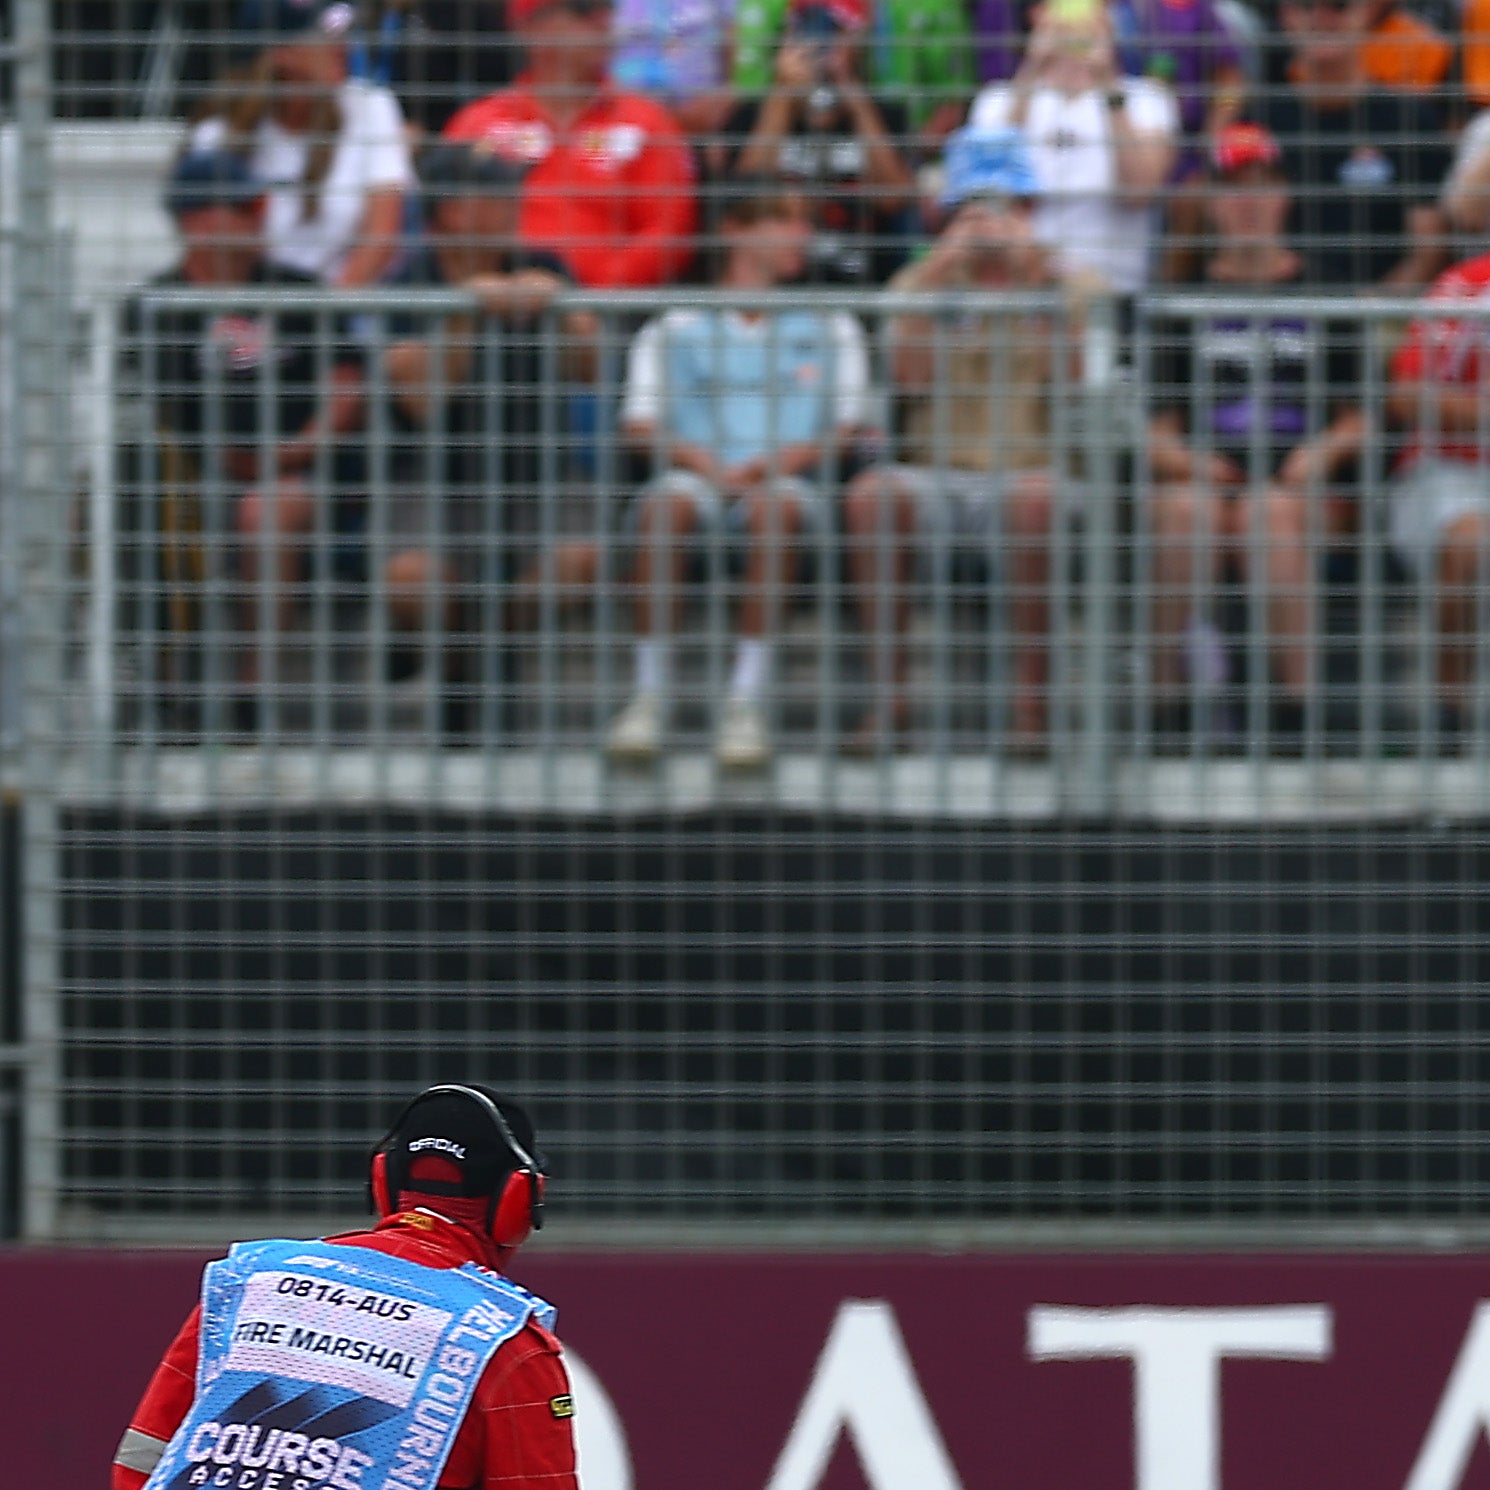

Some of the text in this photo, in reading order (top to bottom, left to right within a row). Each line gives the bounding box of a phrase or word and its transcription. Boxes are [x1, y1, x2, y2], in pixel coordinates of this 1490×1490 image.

[408, 1137, 466, 1160] OFFICIAL
[278, 1276, 417, 1322] 0814-AUS
[287, 1326, 418, 1380] MARSHAL
